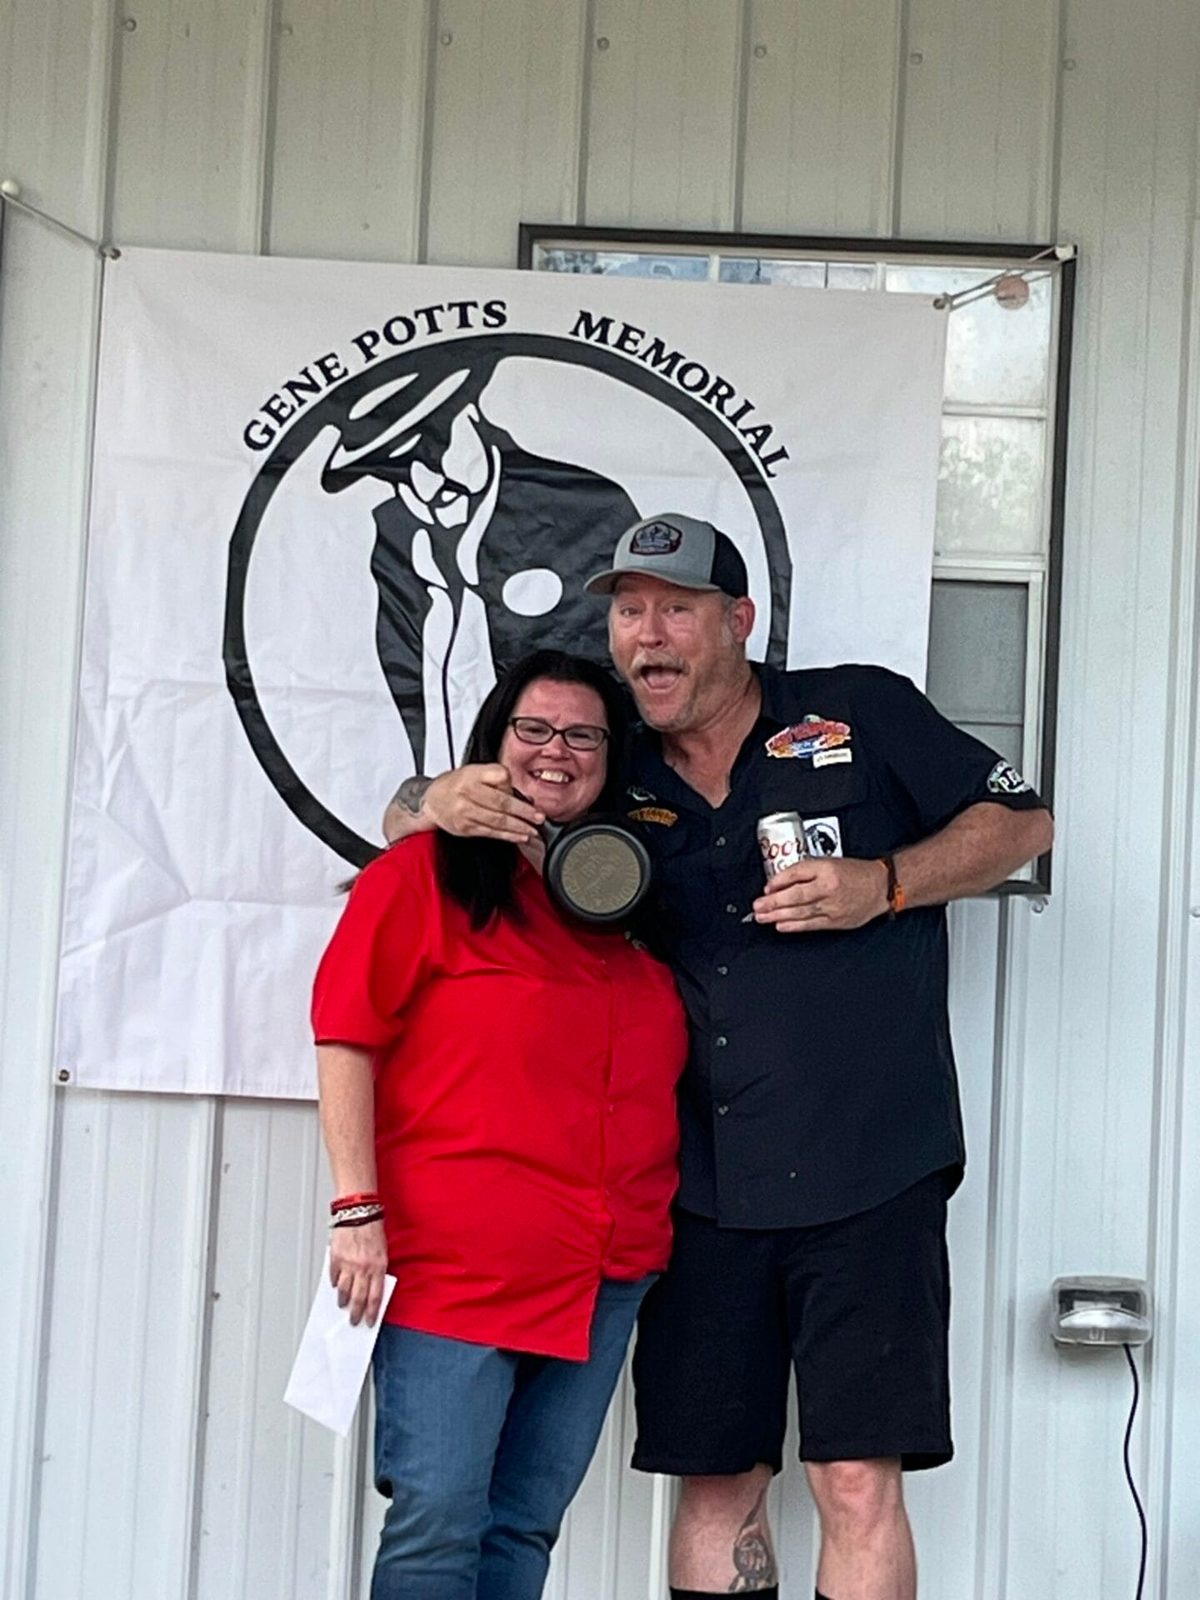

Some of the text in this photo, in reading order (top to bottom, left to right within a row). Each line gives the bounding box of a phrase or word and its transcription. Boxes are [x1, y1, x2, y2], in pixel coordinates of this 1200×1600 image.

[243, 300, 790, 479] GENE POTTS MEMORIAL
